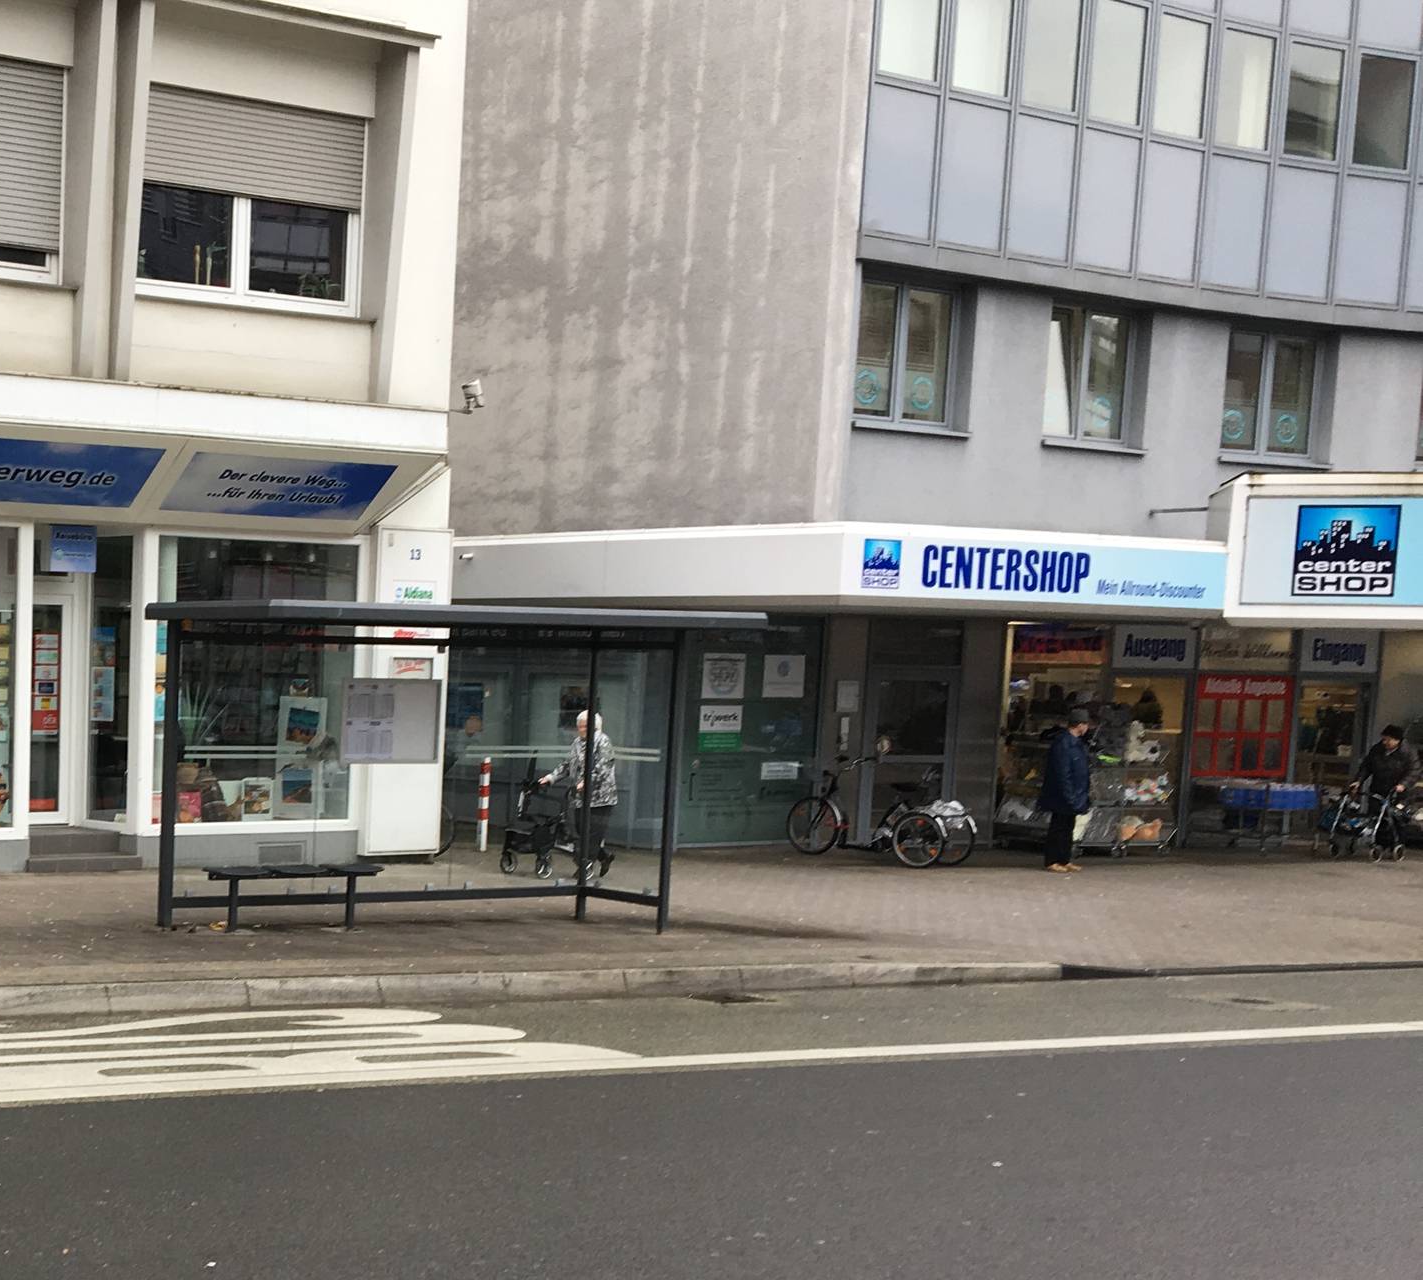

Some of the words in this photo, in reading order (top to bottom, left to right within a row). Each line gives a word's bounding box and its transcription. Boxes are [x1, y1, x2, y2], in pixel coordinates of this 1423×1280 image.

[219, 468, 245, 481] Der
[249, 471, 300, 485] clevere
[247, 489, 286, 502] Ihren
[289, 492, 343, 505] Urlaub!
[409, 548, 422, 561] 13
[921, 544, 1091, 594] CENTERSHOP
[1297, 558, 1392, 573] center
[863, 576, 898, 586] SHOP
[1096, 579, 1117, 595] Mein
[1119, 580, 1206, 599] Allround-Discounter
[1297, 576, 1389, 592] SHOP
[403, 586, 434, 600] Aldiana
[1123, 634, 1186, 662] Ausgang
[1312, 638, 1367, 666] Eingang
